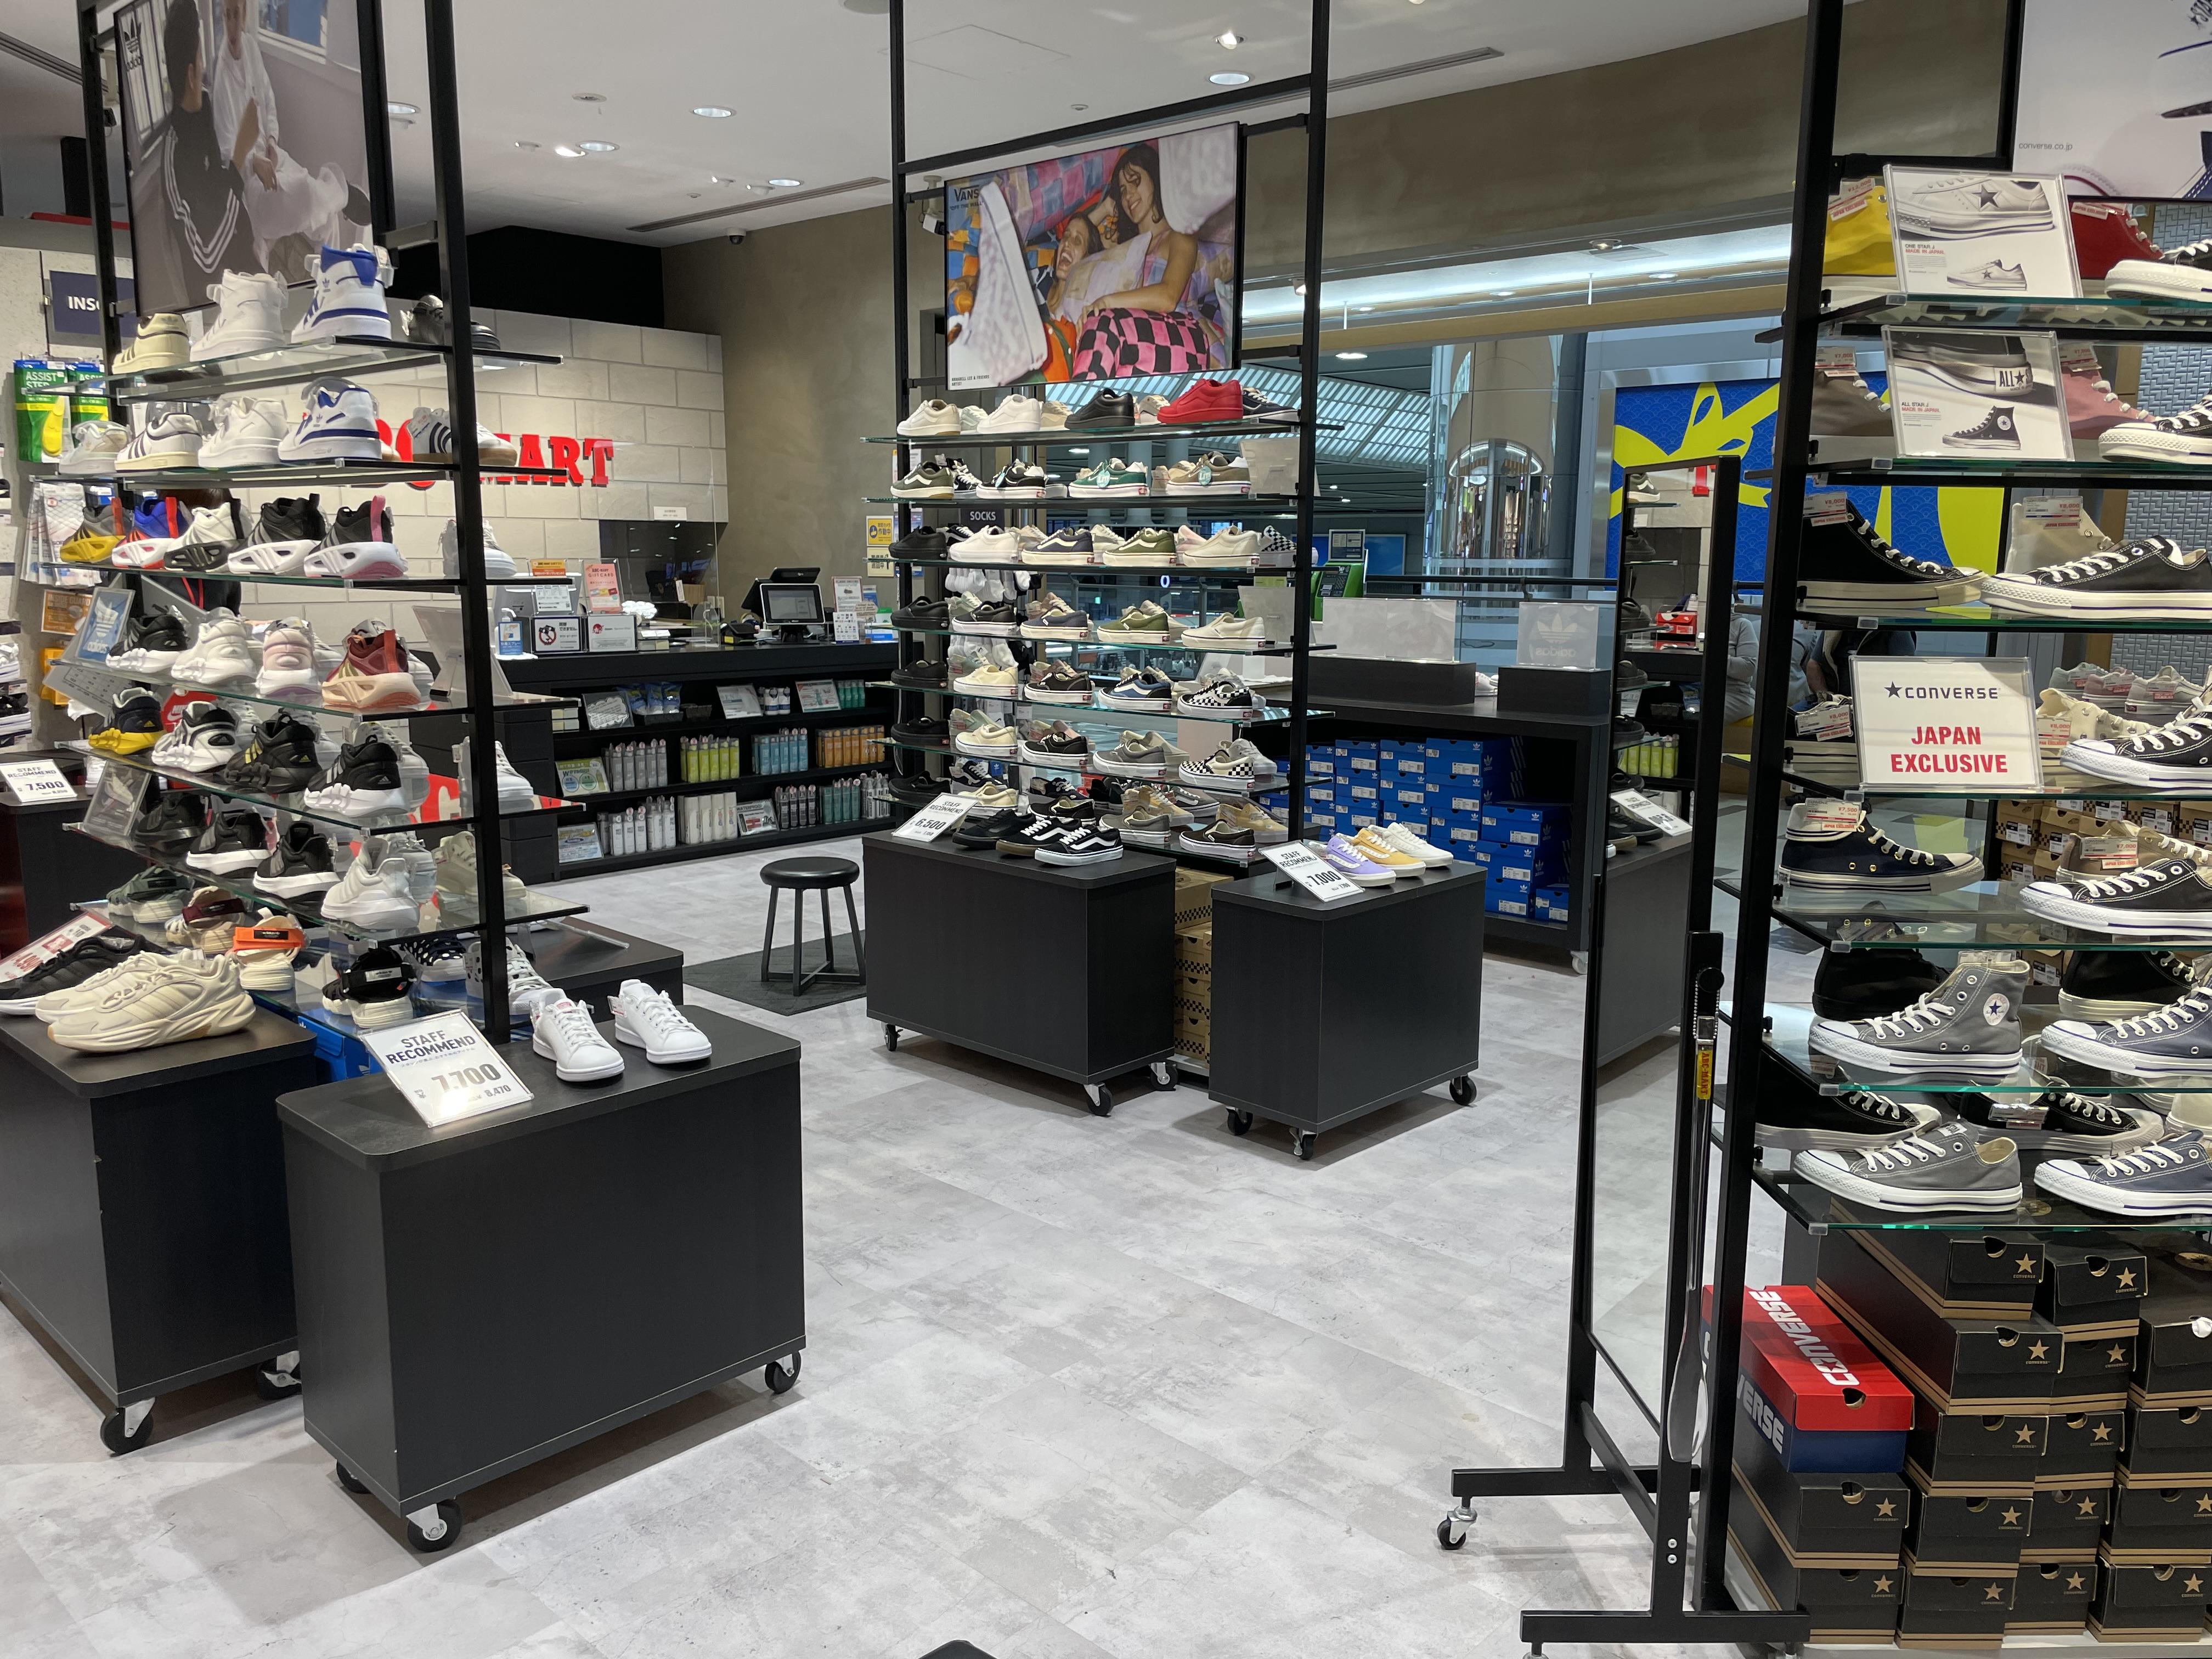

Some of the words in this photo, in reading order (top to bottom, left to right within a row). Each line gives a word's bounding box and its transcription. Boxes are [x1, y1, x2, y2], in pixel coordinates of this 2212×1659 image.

[2018, 142, 2073, 151] converse.co.jp
[954, 185, 980, 202] VANS
[67, 295, 100, 311] INS
[25, 371, 57, 382] ASSIST
[1999, 370, 2015, 387] ALL
[969, 511, 996, 521] SOCKS
[1905, 687, 1998, 699] CONVERSE
[1911, 726, 1982, 745] JAPAN
[1891, 754, 2008, 773] EXCLUSIVE
[7, 770, 57, 778] RECOMMEND
[25, 781, 65, 791] 7,500
[928, 804, 964, 814] RECOMMEND
[915, 818, 947, 830] 6,500
[1280, 851, 1301, 860] STAFF
[1307, 871, 1342, 885] 7,000
[400, 1030, 446, 1048] STAFF
[385, 1035, 476, 1064] RECOMMEND
[1701, 1052, 1710, 1095] ABC-MART
[484, 1085, 511, 1098] 8,470
[1748, 1290, 1860, 1386] CONVERSE
[1736, 1373, 1784, 1455] VERSE
